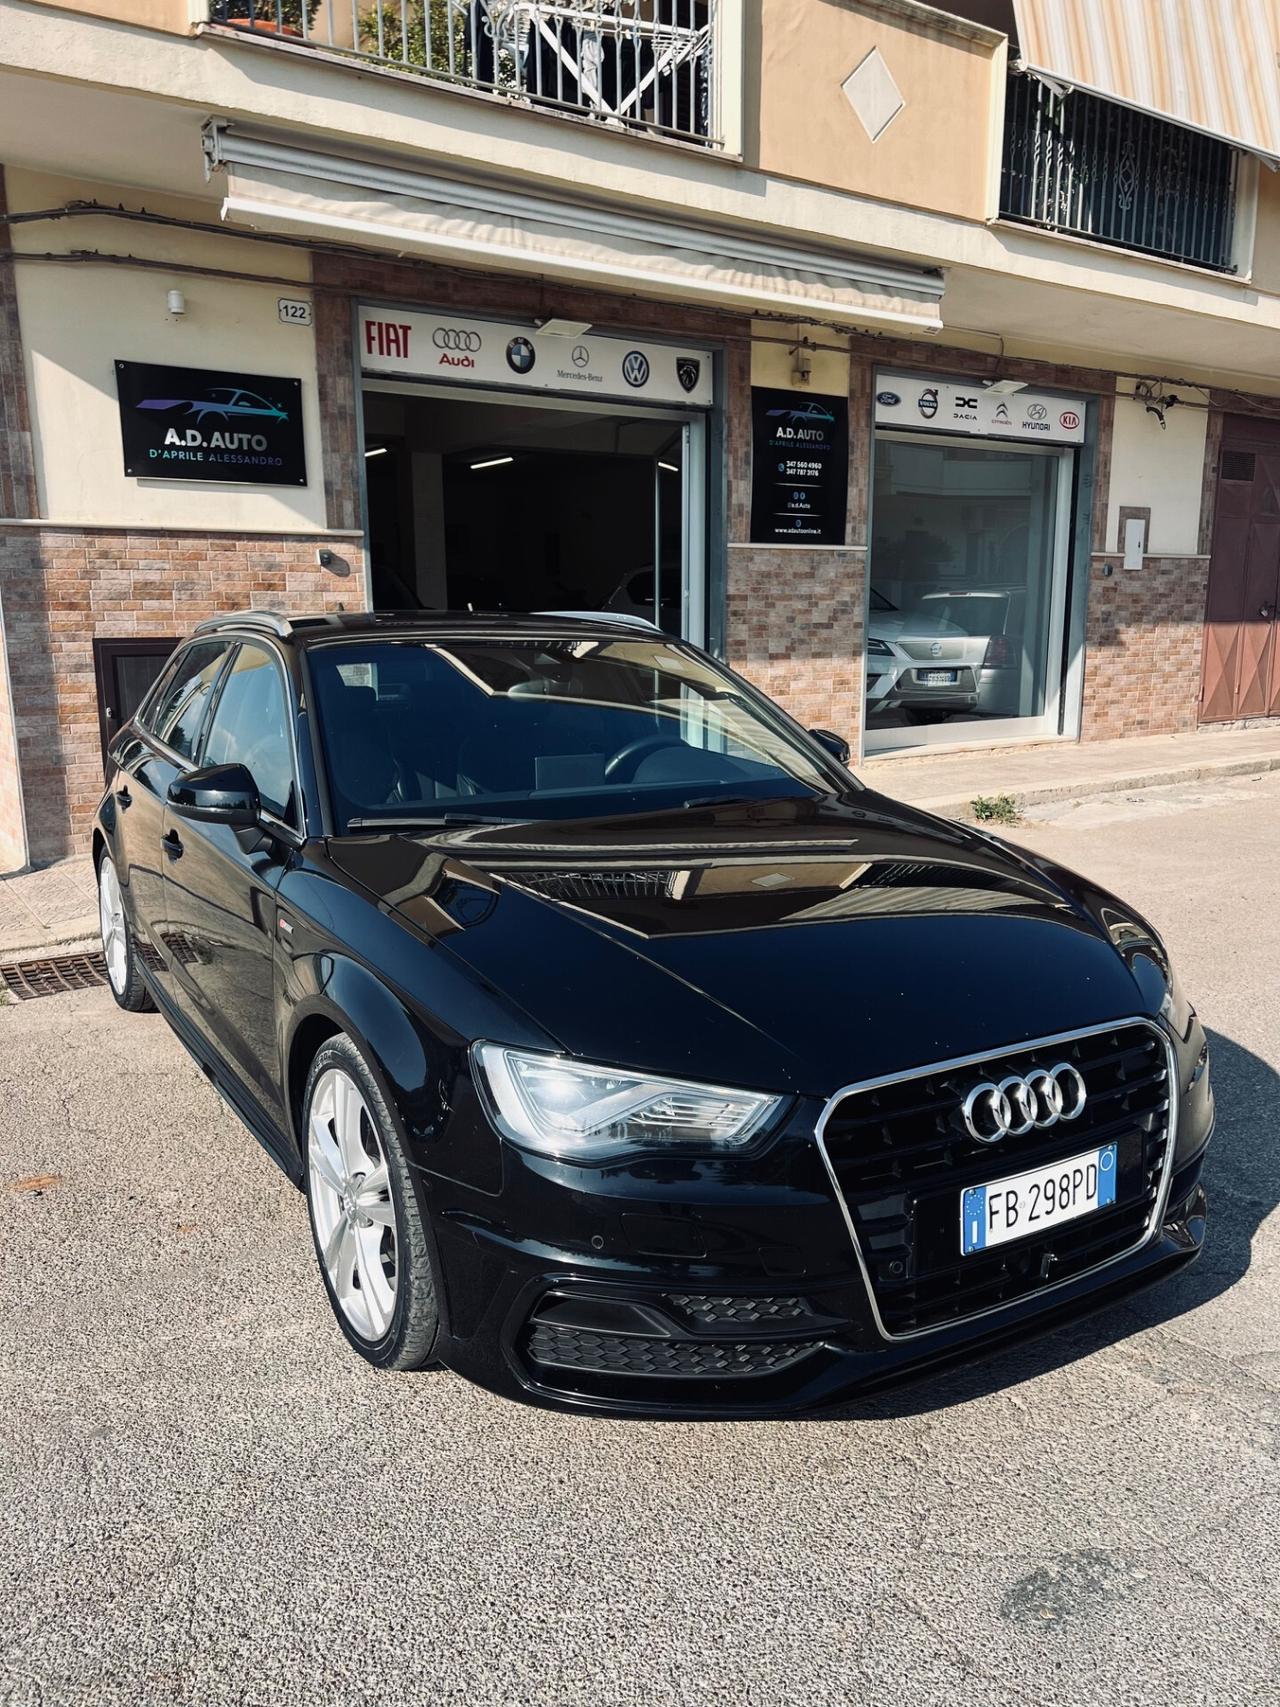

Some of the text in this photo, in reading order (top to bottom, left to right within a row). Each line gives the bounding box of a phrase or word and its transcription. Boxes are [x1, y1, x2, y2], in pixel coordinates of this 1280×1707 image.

[282, 304, 307, 319] 122
[365, 320, 412, 358] FIAT
[439, 353, 475, 368] Audi
[557, 369, 603, 383] Mercedes-Benz
[953, 413, 978, 421] DACIA
[1062, 415, 1077, 425] KIA
[1022, 421, 1050, 431] HYUNDAI
[210, 432, 268, 451] AUTO
[209, 454, 283, 466] ALESSANDRO
[786, 460, 796, 468] 347
[989, 1164, 1097, 1230] FB 298PD
